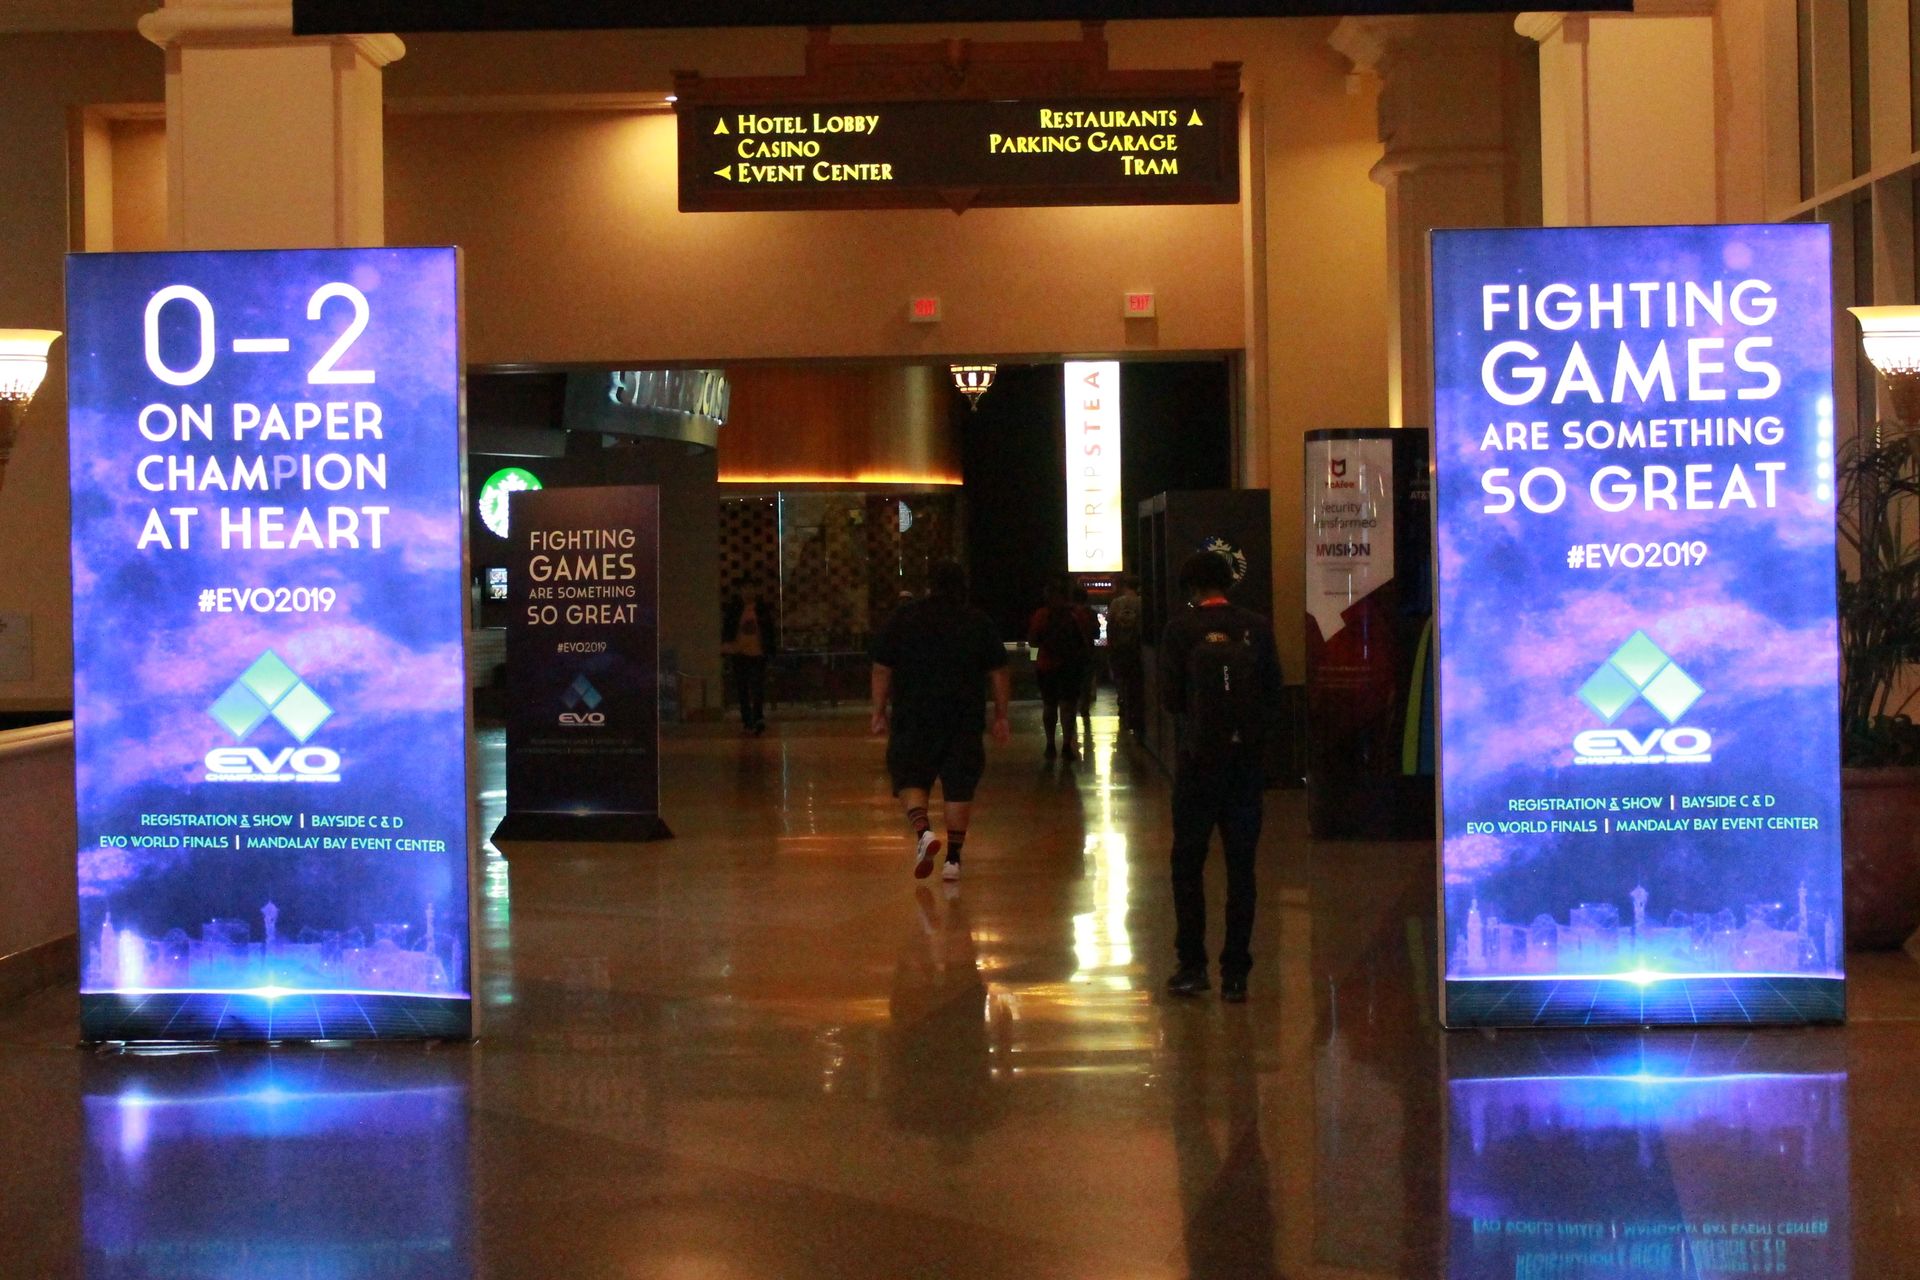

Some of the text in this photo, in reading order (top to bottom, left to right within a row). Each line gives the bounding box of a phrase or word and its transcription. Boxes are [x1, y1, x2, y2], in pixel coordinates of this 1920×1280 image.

[1483, 279, 1777, 330] FIGHTING
[1482, 336, 1781, 406] GAMES
[139, 401, 382, 442] ON PAPER
[1480, 416, 1784, 451] ARE SOMETHING
[137, 453, 386, 491] CHAMPION
[1482, 462, 1786, 514] SO GREAT
[137, 506, 389, 549] AT HEART
[531, 529, 635, 550] FIGHTING
[530, 554, 635, 581] GAMES
[1567, 541, 1707, 568] #EVO2019
[199, 587, 336, 612] #EVO2019
[529, 586, 635, 599] ARE SOMETHING
[528, 604, 637, 624] SO GREAT
[558, 642, 606, 652] #EVO2019
[559, 713, 604, 723] EVO
[1574, 727, 1711, 755] EVO
[205, 747, 340, 773] EVO
[1509, 798, 1606, 810] REGISTRATION
[1622, 797, 1662, 809] SHOW
[1682, 796, 1736, 808] BAYSIDE
[1740, 795, 1748, 807] C
[1765, 795, 1775, 806] D
[142, 814, 237, 826] REGISTRATION
[253, 815, 292, 826] SHOW
[312, 815, 365, 827] BAYSIDE
[369, 816, 377, 827] C
[393, 817, 403, 828] D
[1467, 818, 1818, 834] EVO WORLD FINALS MANDALAY BAY EVENT CENTER
[100, 836, 445, 852] EVO WORLD FINALS MANDALAY BAY EVENT CENTER
